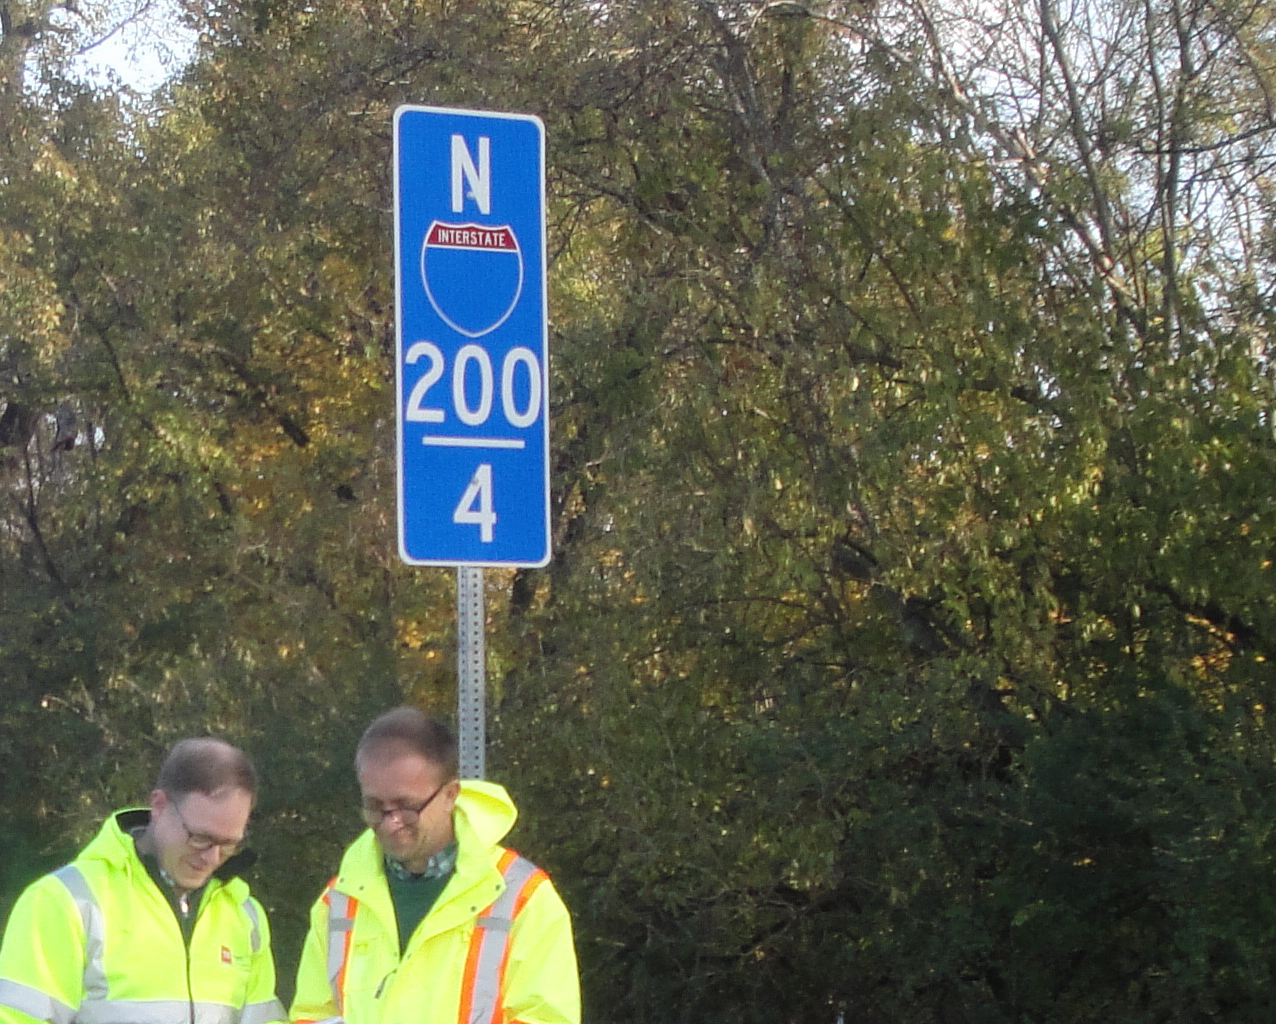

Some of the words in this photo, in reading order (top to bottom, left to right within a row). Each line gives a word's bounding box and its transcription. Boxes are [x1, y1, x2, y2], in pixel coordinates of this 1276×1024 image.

[451, 134, 490, 215] N
[437, 228, 506, 247] INTERSTATE
[405, 341, 542, 428] 200
[453, 463, 497, 543] 4
